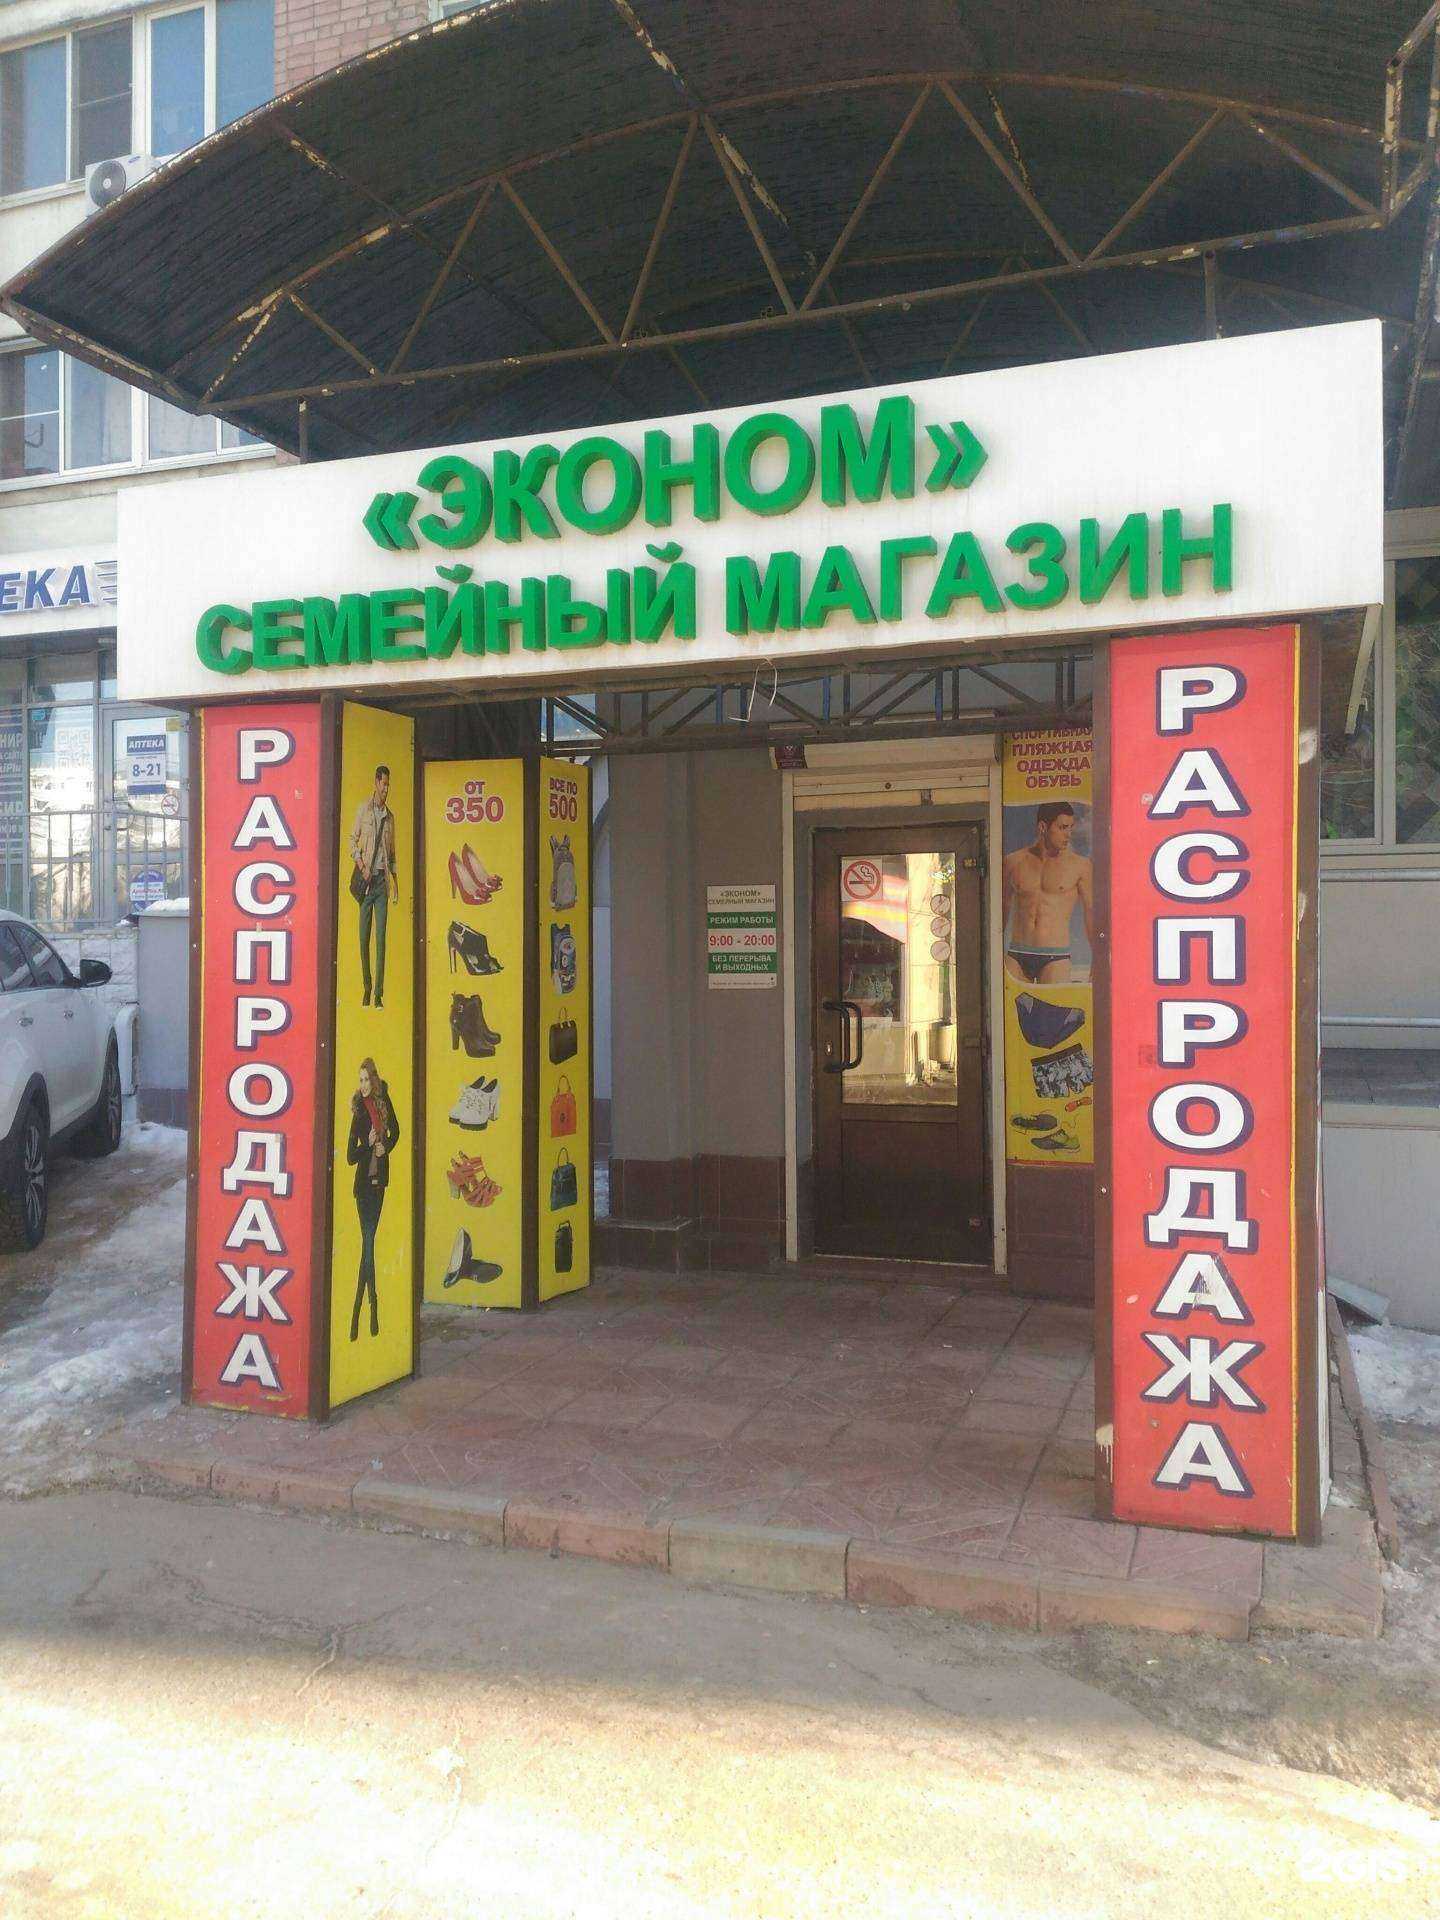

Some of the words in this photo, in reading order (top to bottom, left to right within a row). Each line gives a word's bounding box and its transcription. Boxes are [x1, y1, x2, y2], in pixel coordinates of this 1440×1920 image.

[362, 395, 988, 551] «ЭКОНОМ»
[196, 541, 696, 675] СЕМЕЙНЫЙ
[726, 503, 1233, 637] МАГАЗИН
[128, 739, 165, 748] АПТЕКА
[1013, 740, 1094, 756] ПЛЯЖНАЯ
[132, 763, 161, 777] 8-21
[1017, 757, 1091, 774] ОДЕЖДА
[464, 781, 486, 795] ОТ
[549, 776, 566, 792] ВСЕ
[567, 782, 578, 796] ПО
[1026, 775, 1082, 788] ОБУВЬ
[446, 795, 505, 823] 350
[549, 794, 578, 822] 500
[710, 916, 739, 924] РЕЖИМ
[741, 915, 774, 924] РАБОТЫ
[709, 935, 733, 946] 9:00
[744, 934, 775, 946] 20:00
[712, 955, 728, 963] БЕЗ
[729, 954, 772, 962] ПЕРЕРЫВА
[723, 963, 769, 972] ВЫХОДНЫХ
[215, 728, 296, 1391] РАСПРОДАЖА
[1142, 664, 1264, 1497] РАСПРОДАЖА
